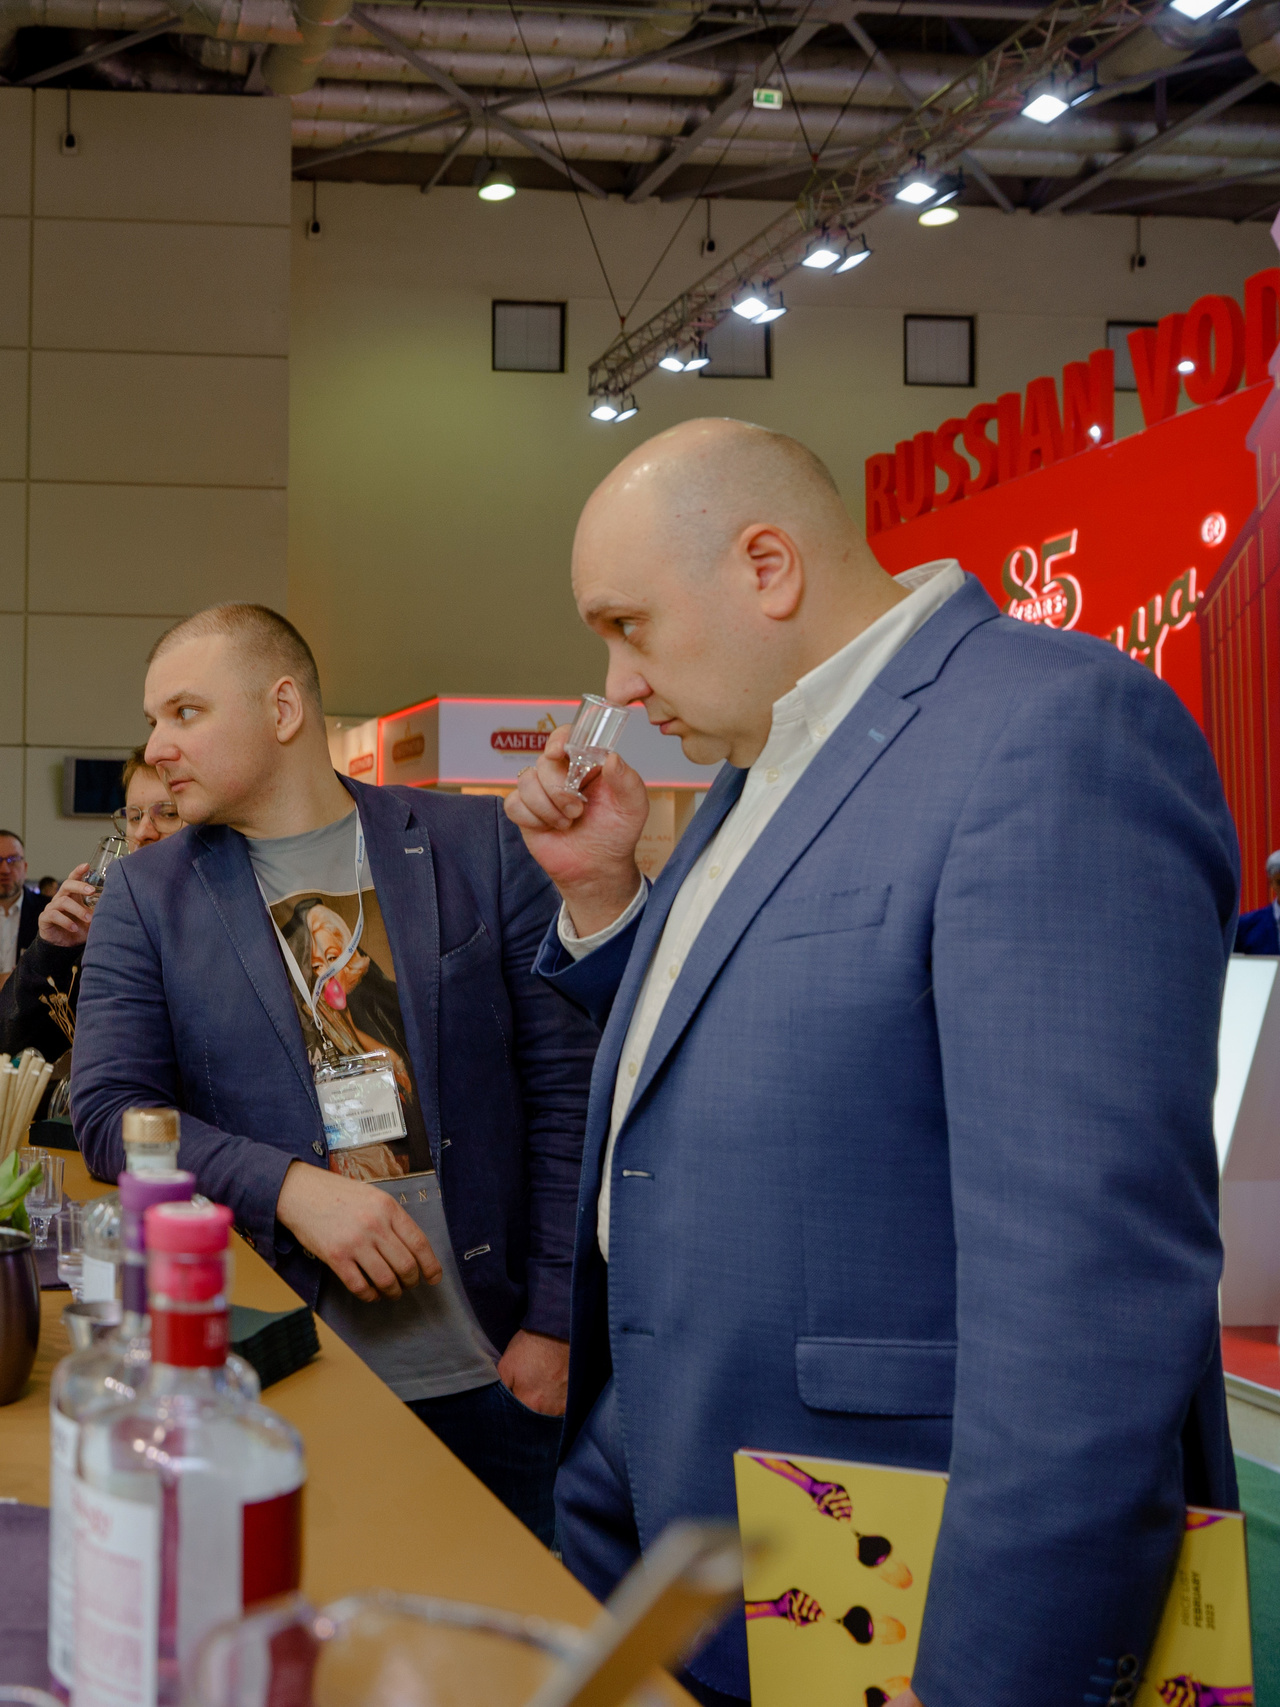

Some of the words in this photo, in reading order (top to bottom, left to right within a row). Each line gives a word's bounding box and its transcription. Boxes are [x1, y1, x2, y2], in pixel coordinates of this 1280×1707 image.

[865, 349, 1115, 538] RUSSIAN
[1001, 528, 1082, 632] 85
[493, 733, 549, 749] АЛЬТЕР
[1191, 1570, 1202, 1628] FEBRUARY
